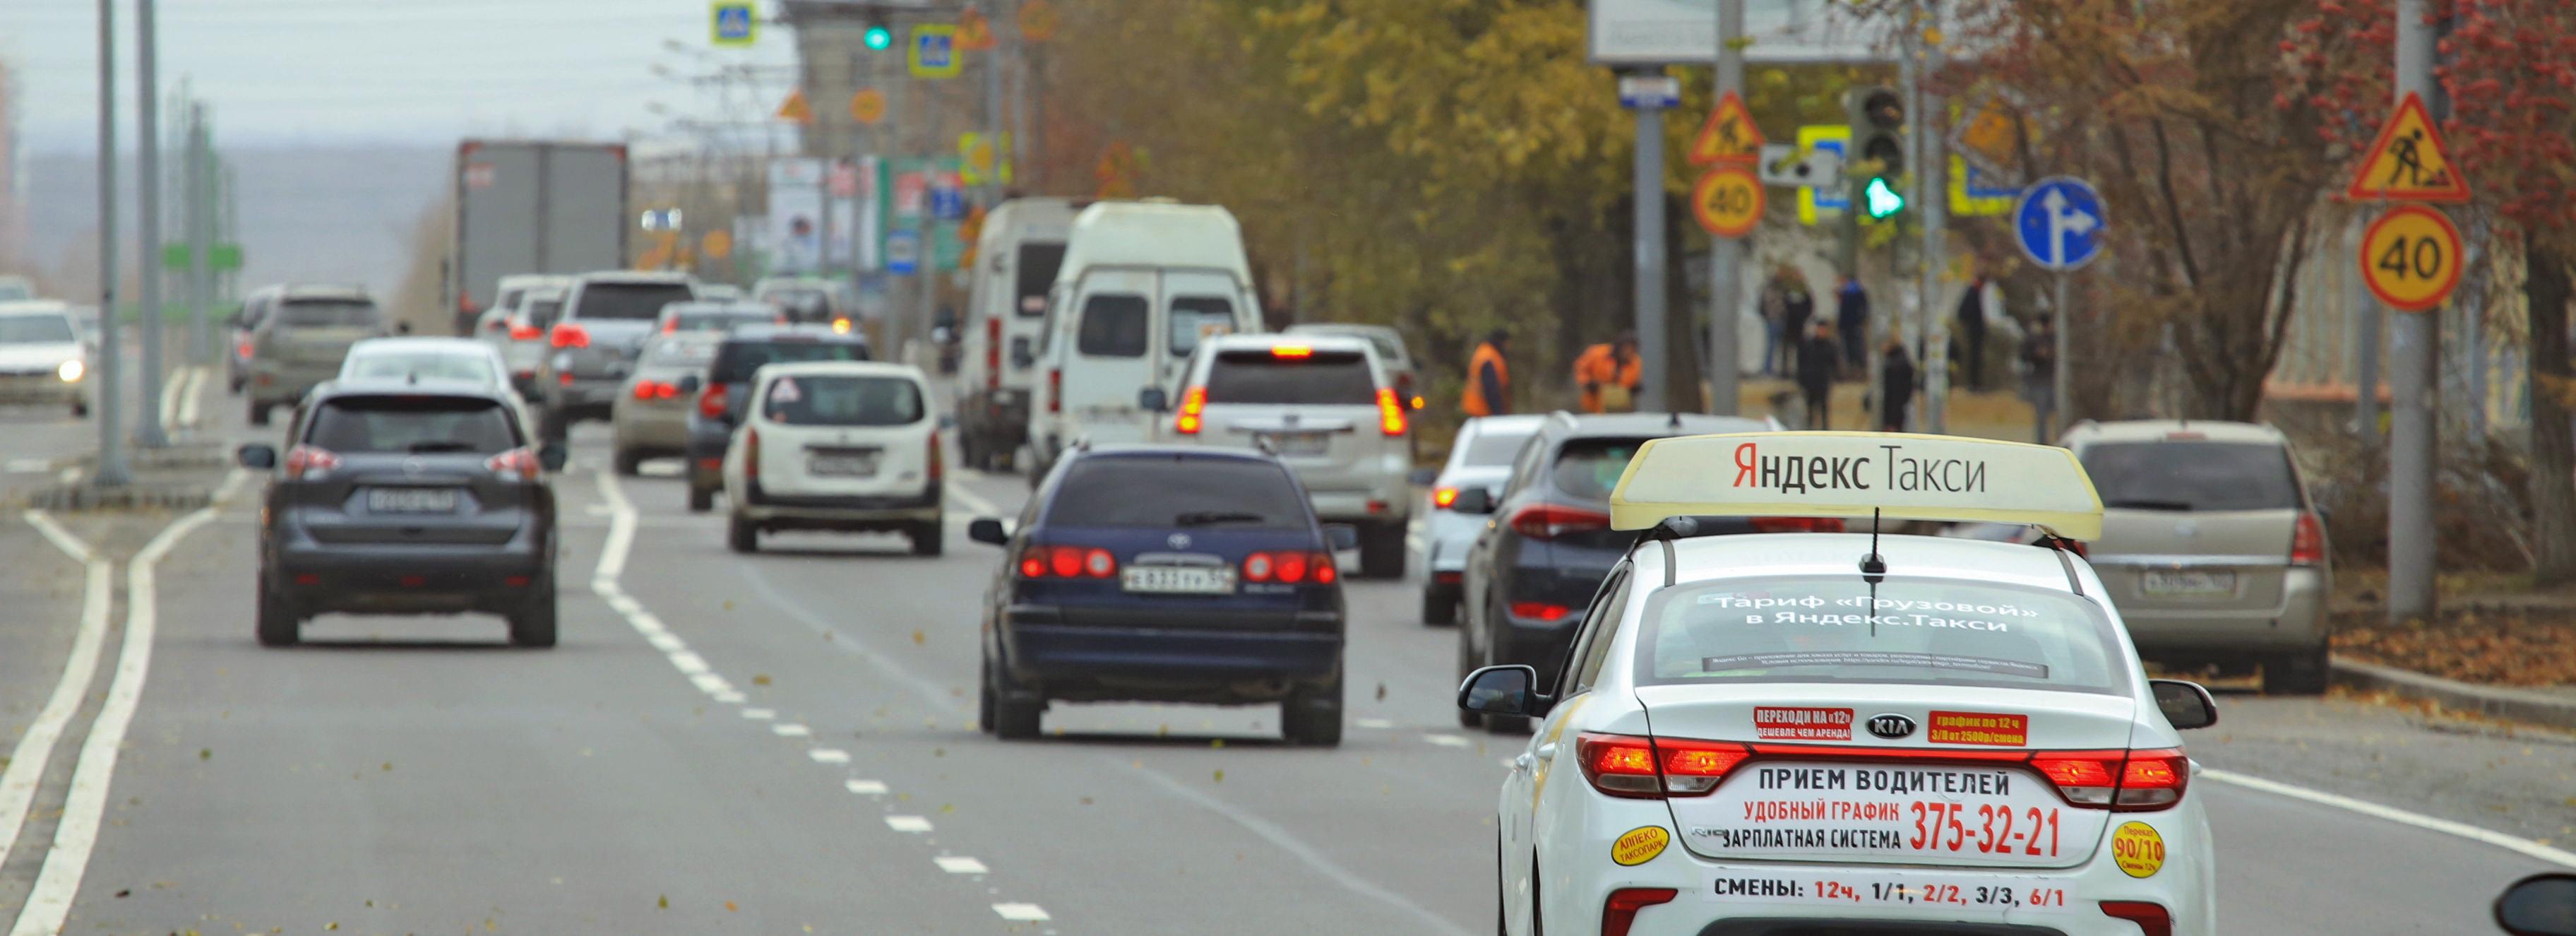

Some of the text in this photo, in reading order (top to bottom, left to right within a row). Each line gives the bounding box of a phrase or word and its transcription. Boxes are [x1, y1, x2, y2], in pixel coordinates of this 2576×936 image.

[1708, 185, 1753, 215] 40
[2378, 235, 2441, 280] 40
[1733, 442, 1985, 494] Яндекс Такси
[1715, 596, 2039, 617] Тариф «Грузовой»
[1746, 611, 2008, 632] в Яндекс.Такси
[1757, 709, 1850, 725] ПЕРЕХОДИ НА «12»
[1874, 718, 1909, 734] KIA
[1937, 716, 2020, 728] график по 12 ч
[1758, 727, 1850, 738] ДЕШЕВЛЕ ЧЕМ АРЕНДА!
[1949, 732, 1960, 741] от
[1961, 730, 2024, 744] 2500р/смена
[1759, 769, 2010, 796] ПРИЕМ ВОДИТЕЛЕЙ
[1743, 798, 1900, 822] УДОБНЫЙ ГРАФИК
[1619, 828, 1657, 851] АЛПЕКО
[1723, 828, 1902, 849] ЗАРПЛАТНАЯ СИСТЕМА
[1909, 800, 2060, 857] 375-32-21
[1620, 839, 1666, 862] ТАКСОПАРК
[2115, 837, 2163, 861] 90/10
[1714, 877, 2065, 907] СМЕНЫ: 12ч, 1/1, 2/2, 3/3, 6/1
